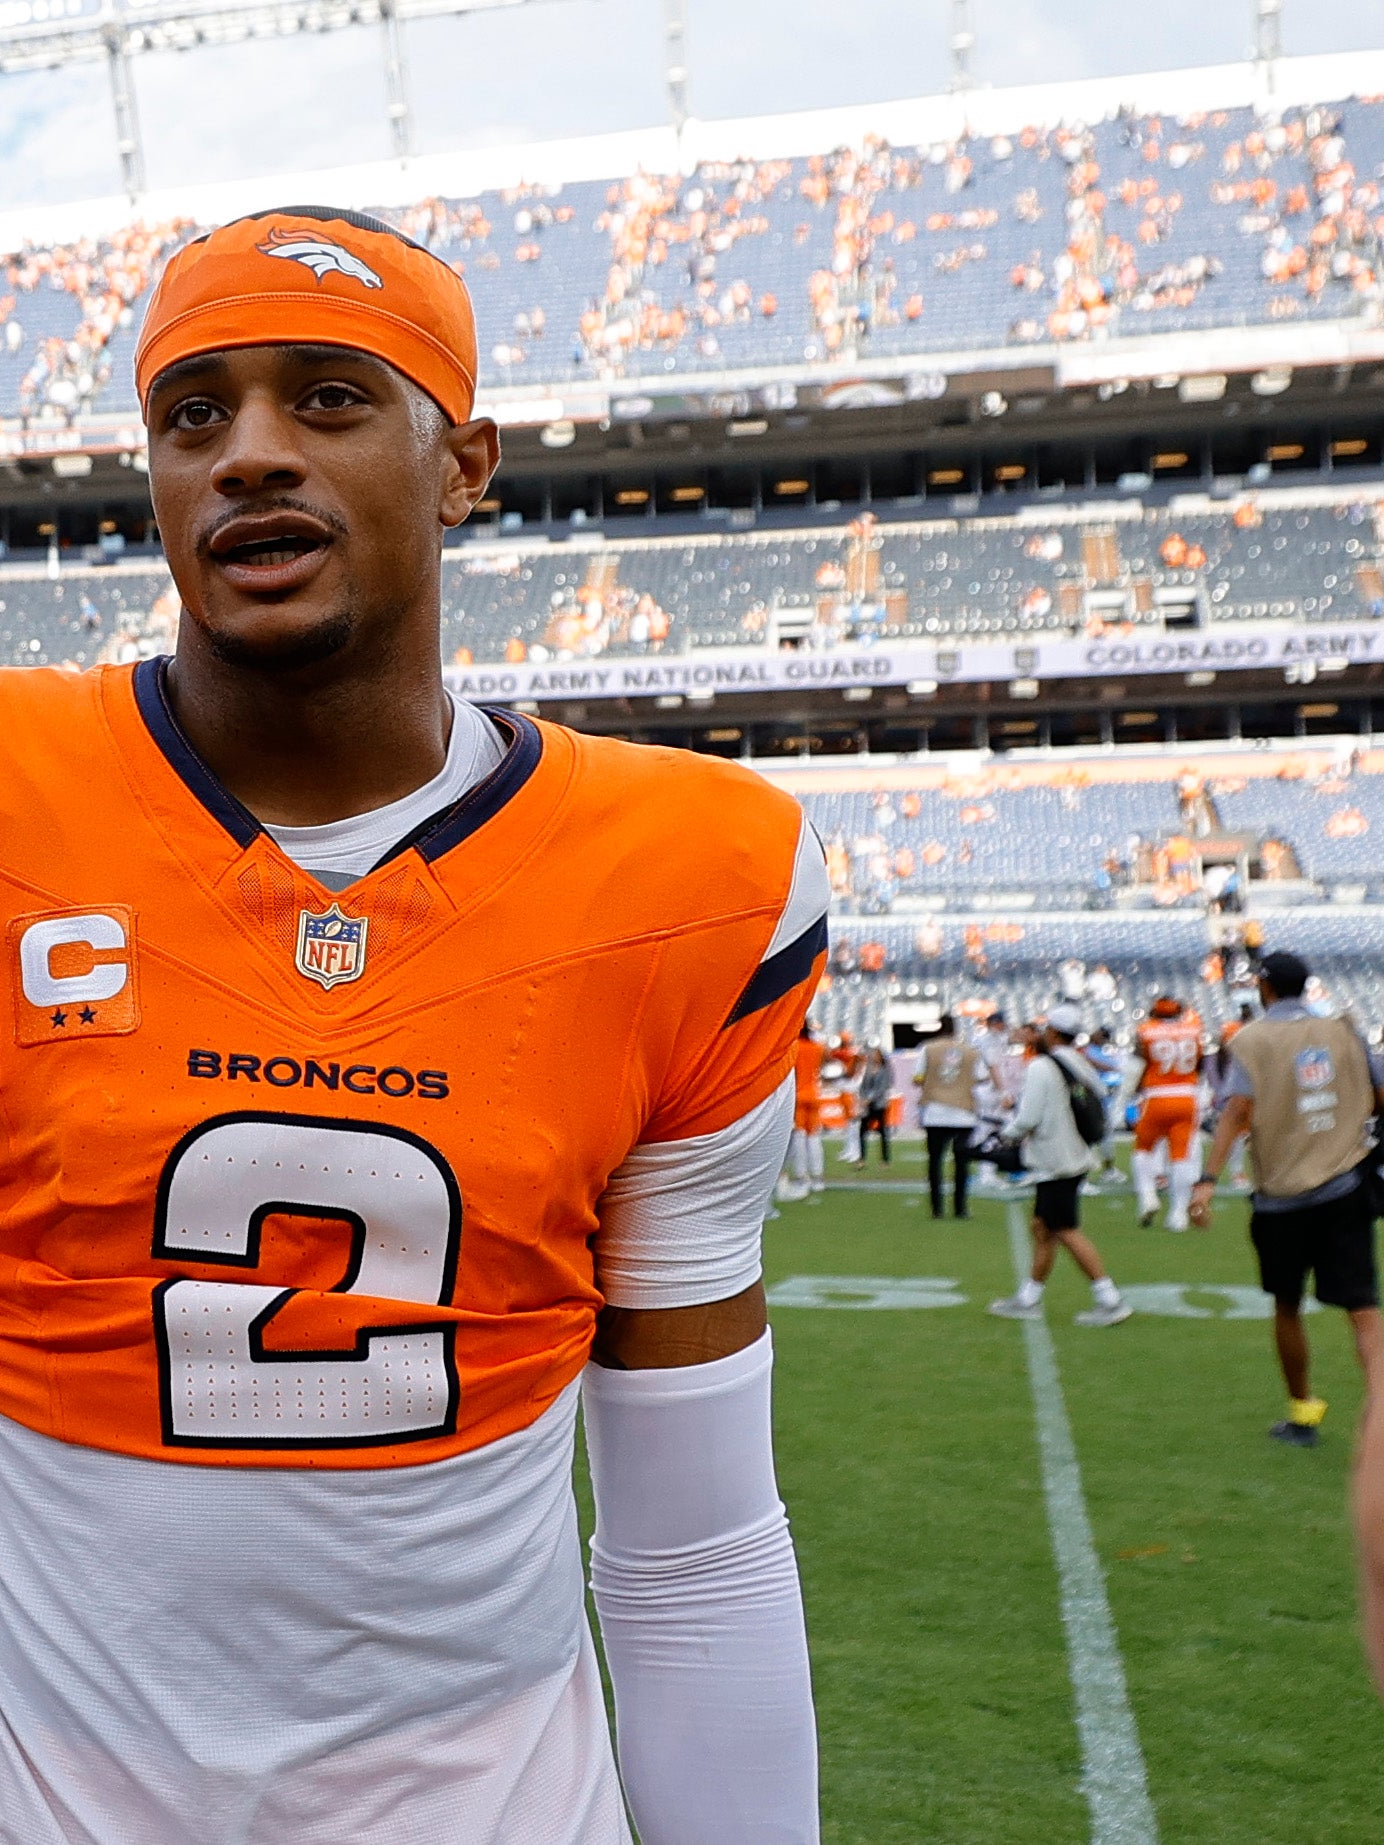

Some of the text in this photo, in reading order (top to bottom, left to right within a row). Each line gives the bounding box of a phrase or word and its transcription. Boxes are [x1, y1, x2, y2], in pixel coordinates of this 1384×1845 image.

[1087, 634, 1378, 664] COLORADO ARMY
[444, 657, 892, 694] ADO ARMY NATIONAL GUARD
[20, 914, 128, 1007] C
[306, 940, 353, 974] NFL
[187, 1048, 450, 1100] BRONCOS
[1148, 1039, 1198, 1075] 98
[151, 1110, 463, 1451] 2
